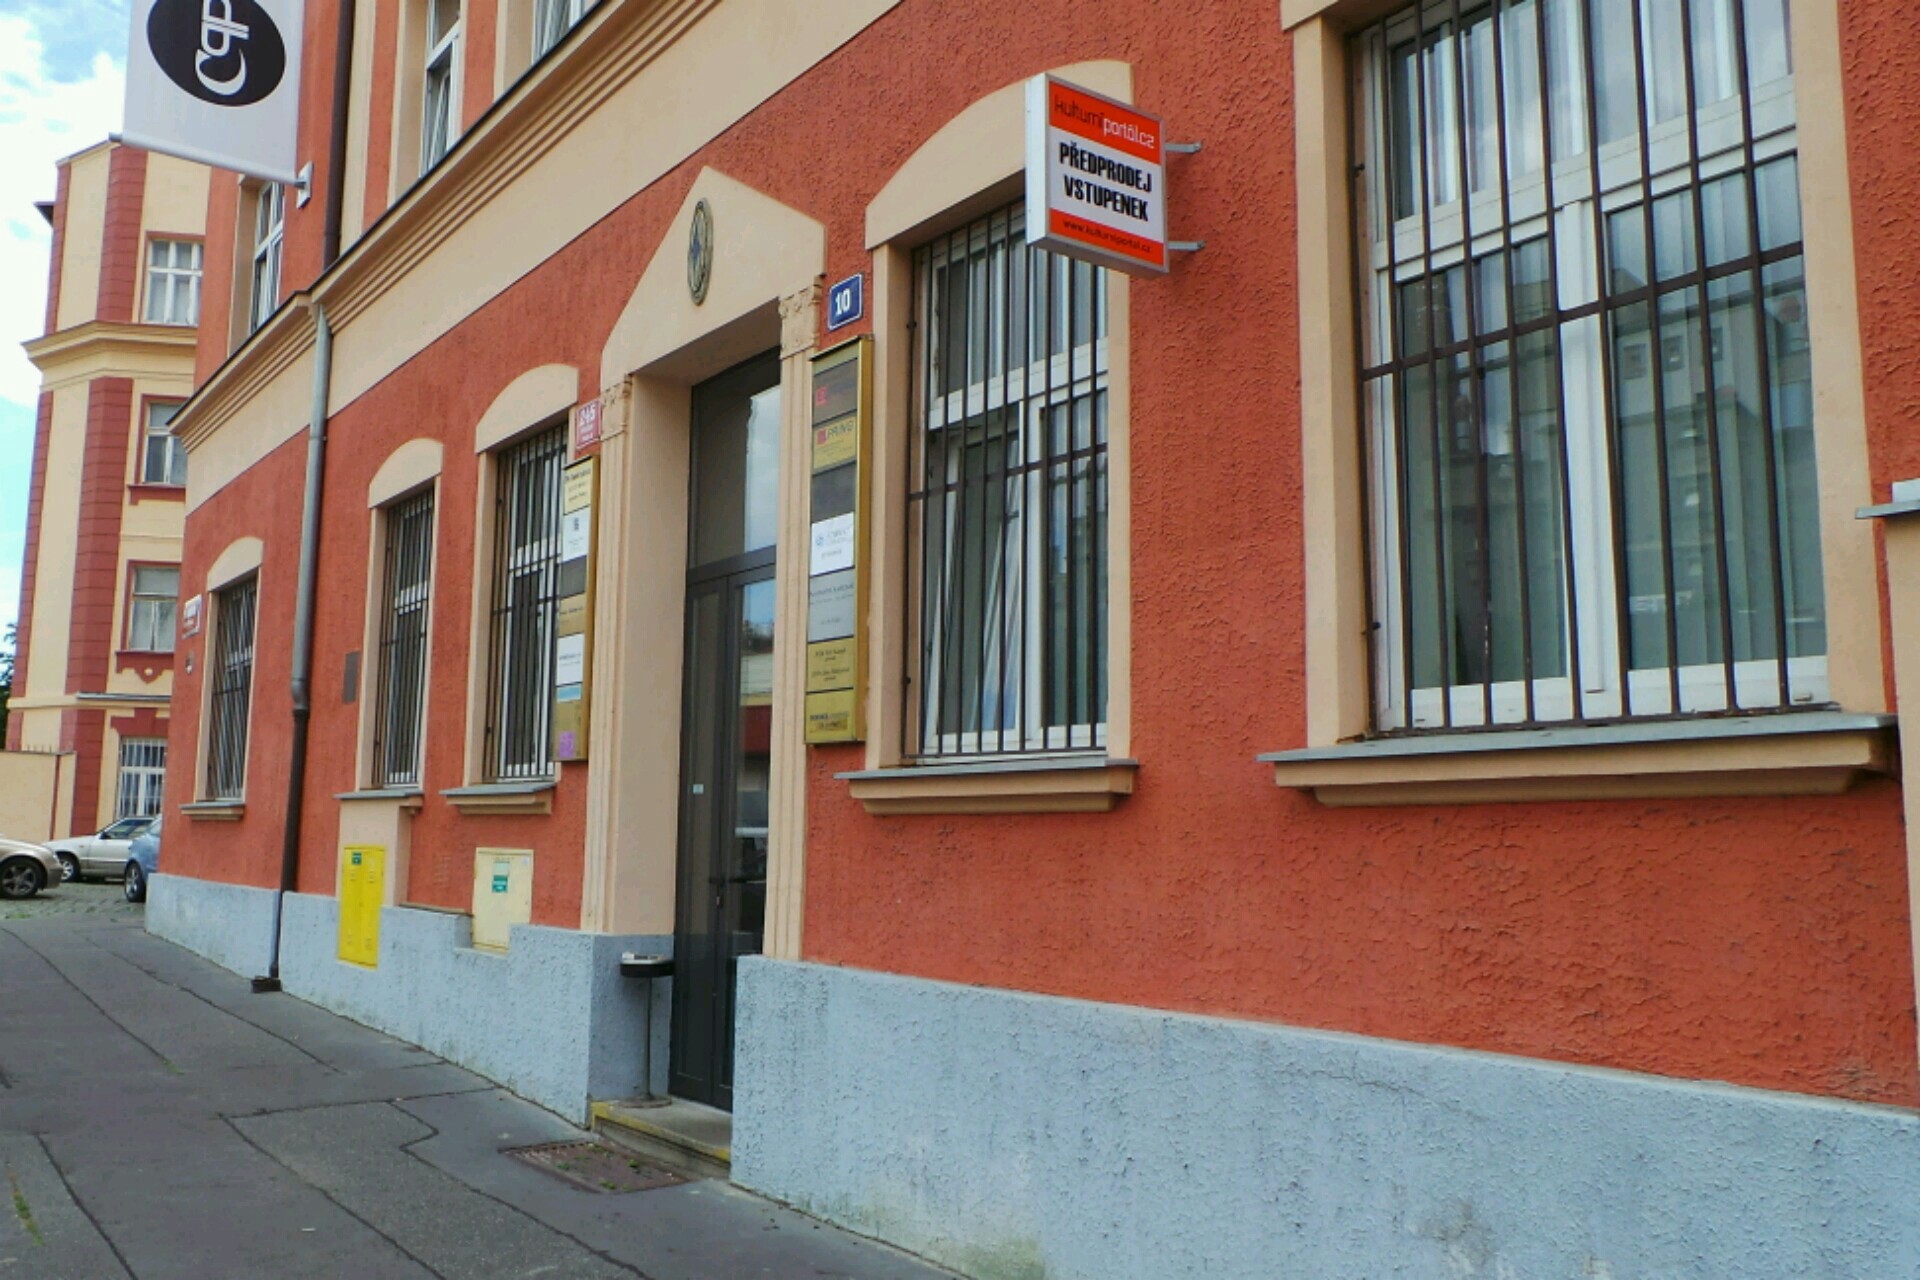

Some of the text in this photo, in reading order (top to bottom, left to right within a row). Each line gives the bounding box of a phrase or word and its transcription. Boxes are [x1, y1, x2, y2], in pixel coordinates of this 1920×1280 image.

[1058, 139, 1153, 193] PŘEDPRODEJ
[1063, 174, 1149, 222] VSTUPENEK
[834, 288, 852, 317] 10
